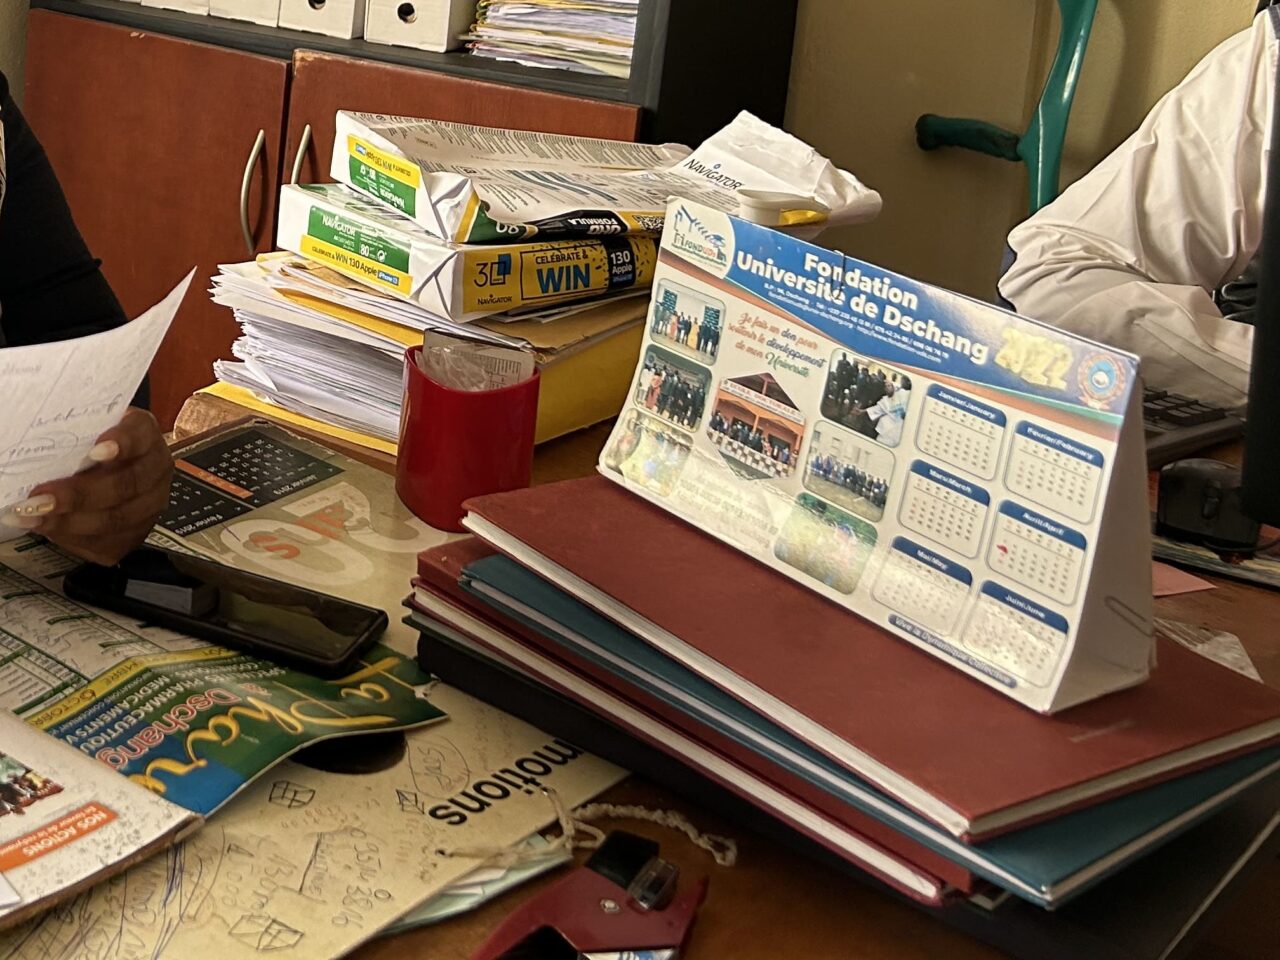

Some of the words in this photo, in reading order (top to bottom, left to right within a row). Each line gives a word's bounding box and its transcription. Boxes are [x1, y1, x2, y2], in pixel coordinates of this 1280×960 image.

[683, 159, 742, 190] NAVIGATOR
[321, 214, 356, 237] NAVIGATOR
[335, 251, 348, 264] WIN
[349, 256, 360, 269] 130
[360, 262, 377, 276] Apple
[360, 243, 370, 257] 80
[610, 250, 631, 265] 130
[536, 263, 590, 294] WIN
[612, 263, 633, 274] Apple
[804, 252, 919, 311] Fondation
[477, 295, 512, 305] NAVIGATOR
[736, 250, 846, 306] Université
[850, 294, 879, 319] de
[883, 304, 990, 365] Dschang
[781, 328, 797, 342] don
[75, 674, 170, 738] MEDICAMENTS
[96, 688, 242, 770] Dschang
[428, 739, 585, 827] motions
[77, 810, 107, 830] NOS
[22, 825, 78, 857] ACTIONS
